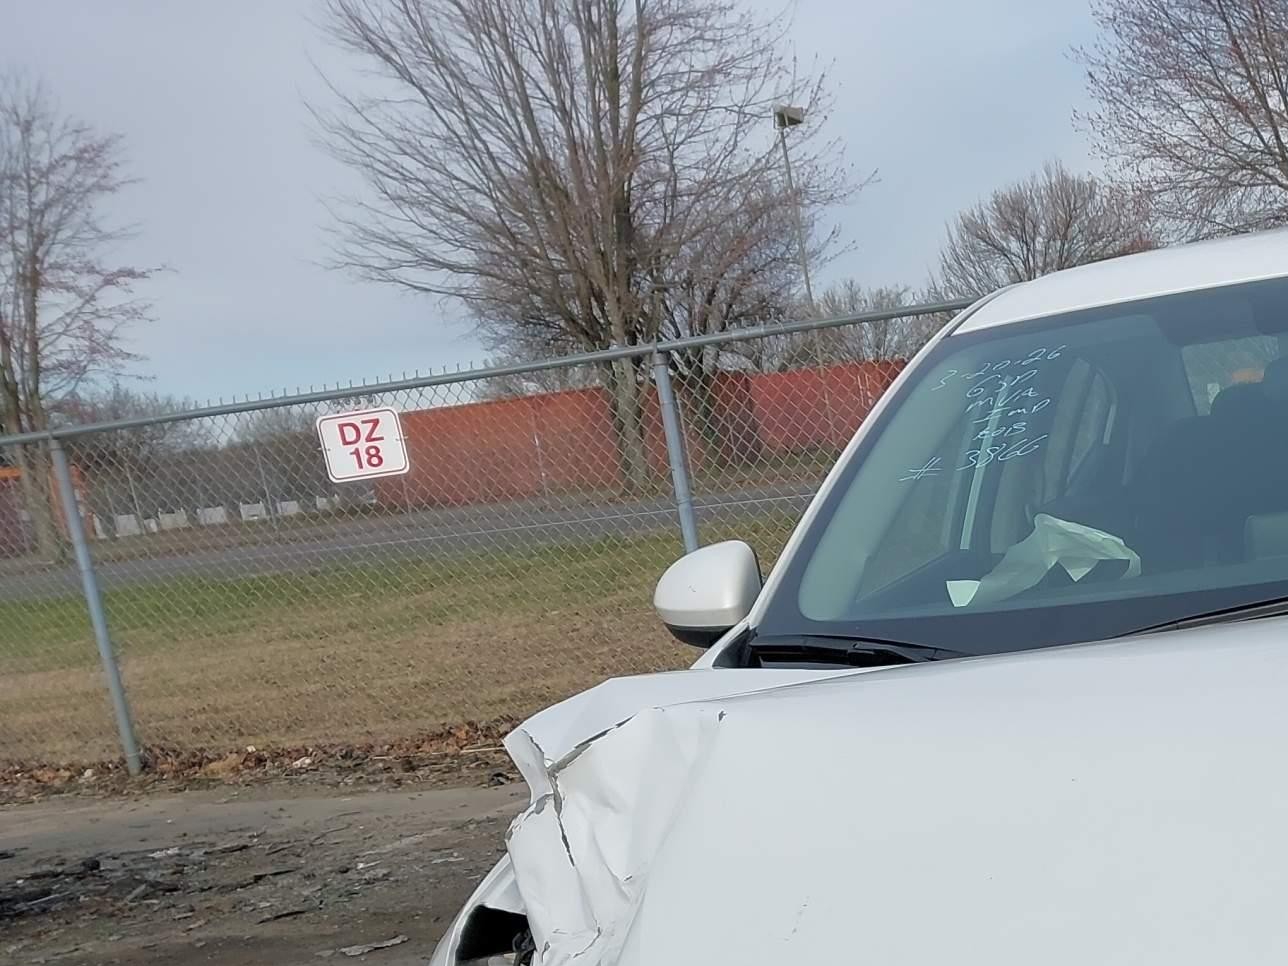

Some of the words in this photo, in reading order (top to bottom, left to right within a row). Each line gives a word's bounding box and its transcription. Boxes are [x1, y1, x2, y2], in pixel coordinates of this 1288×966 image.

[338, 418, 384, 446] DZ
[349, 445, 384, 470] 18
[956, 434, 1049, 472] 3866
